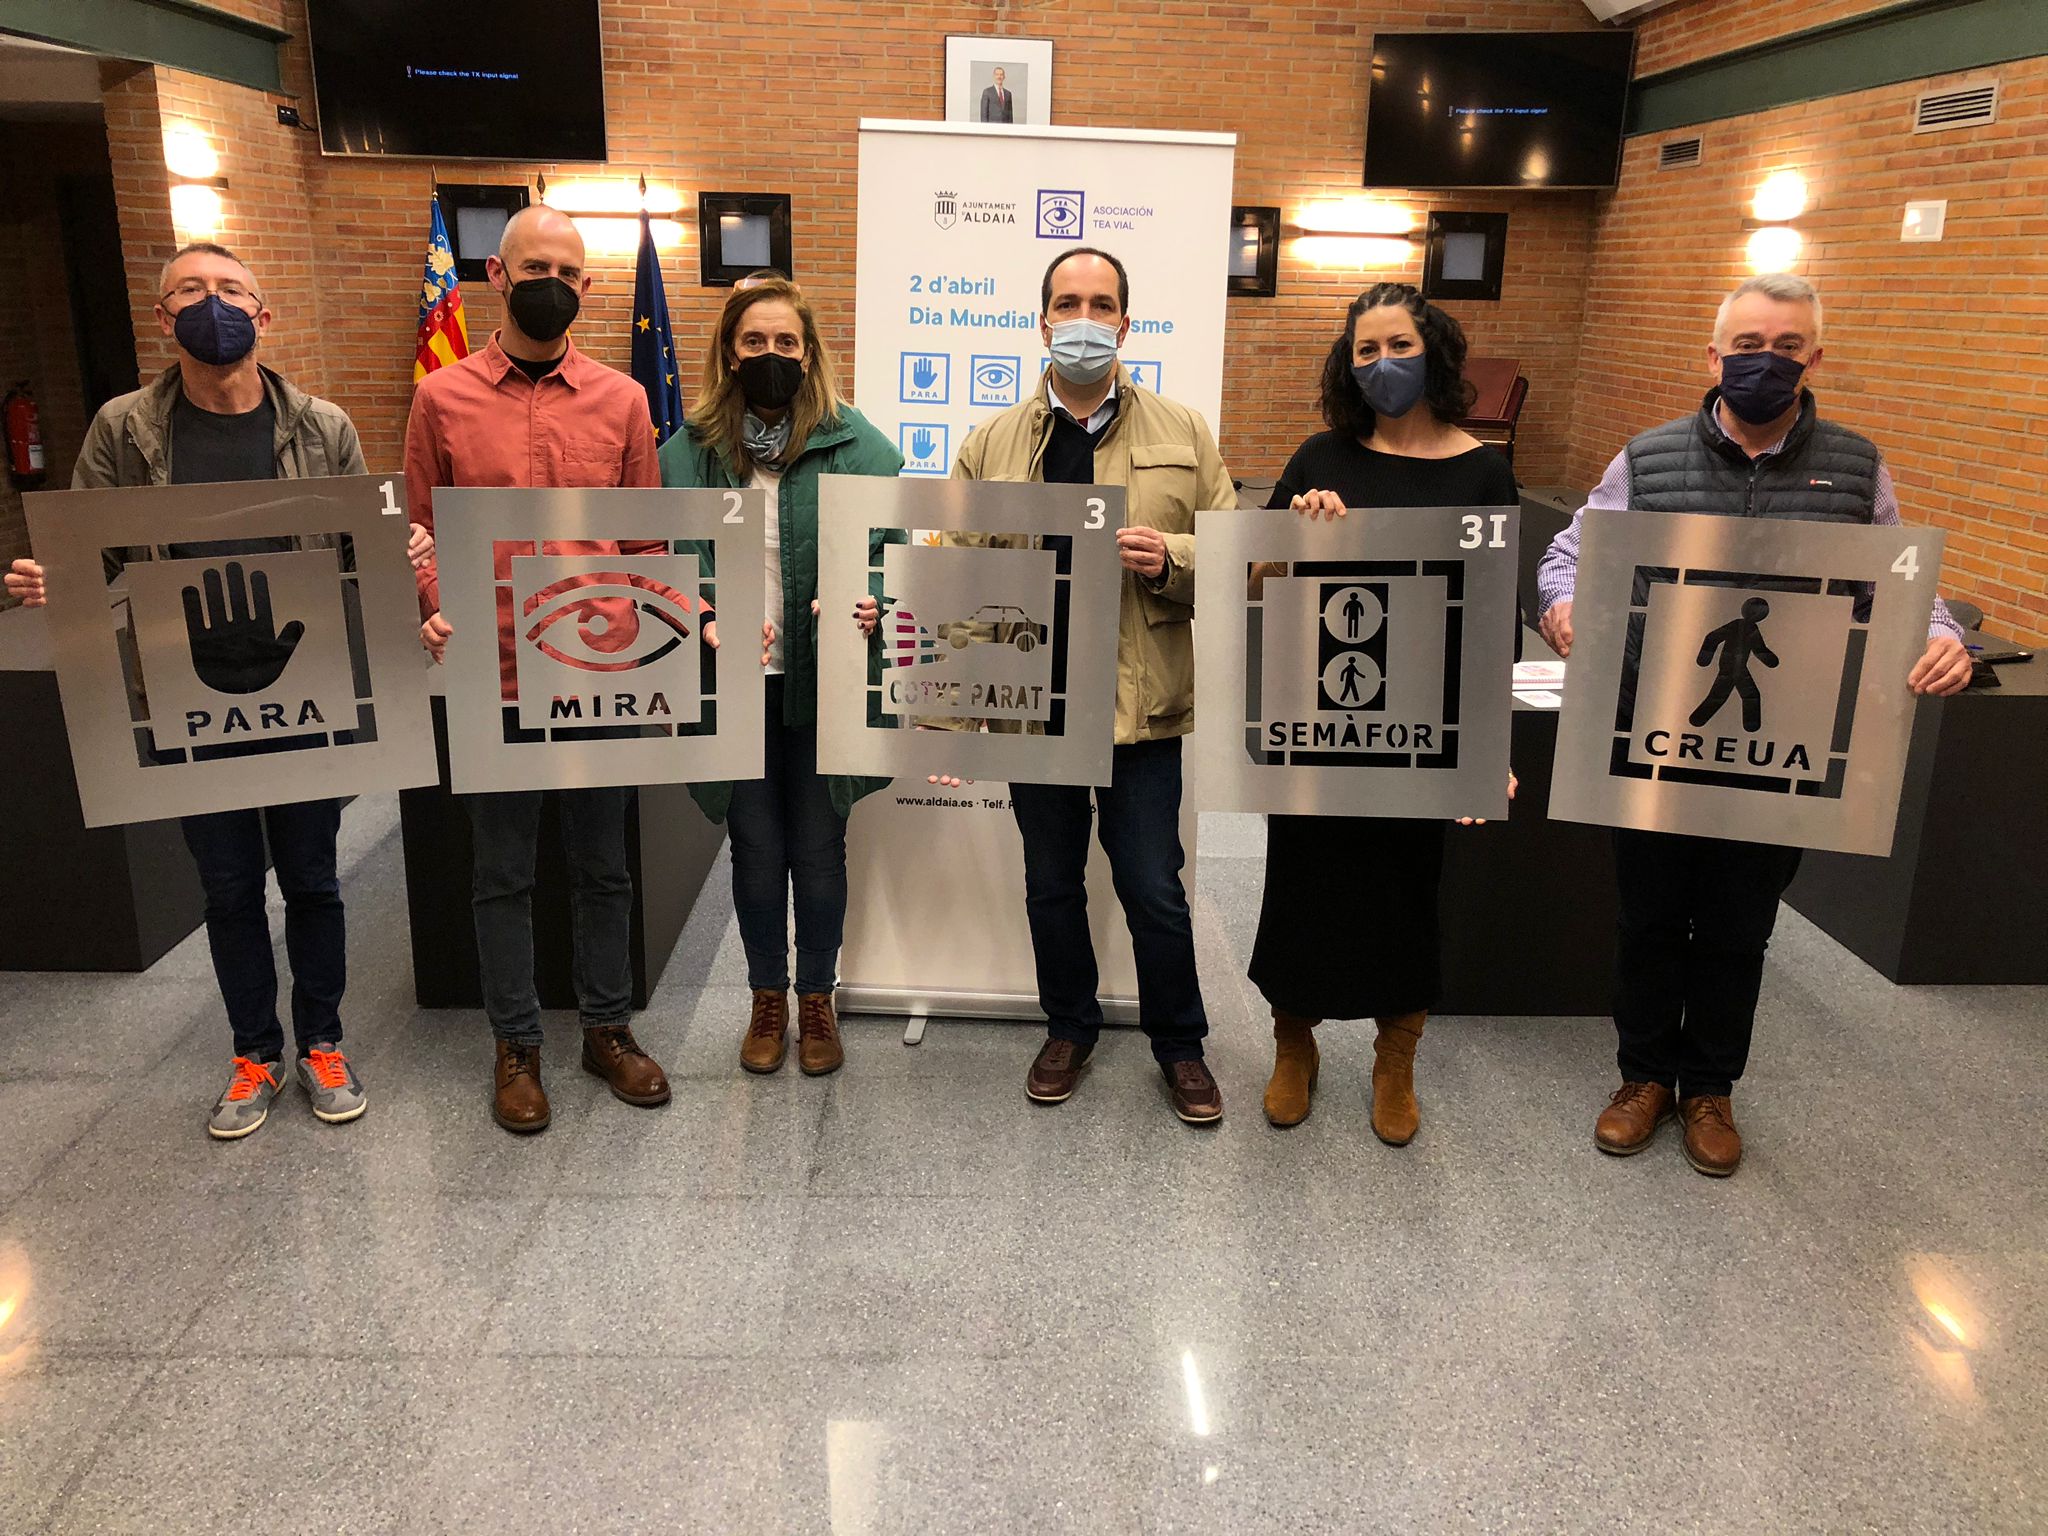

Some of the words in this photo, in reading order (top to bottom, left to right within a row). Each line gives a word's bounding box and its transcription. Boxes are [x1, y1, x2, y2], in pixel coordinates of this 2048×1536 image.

[414, 68, 437, 76] Please
[962, 201, 1016, 211] AJUNTAMENT
[1093, 205, 1154, 217] ASOCIACIÓN
[1093, 219, 1111, 229] TEA
[1113, 220, 1135, 230] VIAL
[909, 274, 922, 294] 2
[909, 306, 944, 326] Dia
[950, 308, 1036, 330] Mundial
[910, 391, 938, 399] PARA
[981, 393, 1008, 401] MIRA
[909, 461, 937, 469] PARA
[378, 480, 402, 516] 1
[722, 491, 744, 524] 2
[1083, 497, 1106, 530] 3
[1890, 545, 1920, 581] 4
[550, 692, 672, 719] MIRA
[889, 679, 961, 707] COTXE
[971, 683, 1043, 710] PARAT
[185, 699, 325, 737] PARA
[1268, 713, 1434, 749] SEMÀFOR
[1644, 729, 1811, 772] CREUA
[896, 796, 974, 808] www.aldaia.es
[982, 798, 1005, 810] Telf.
